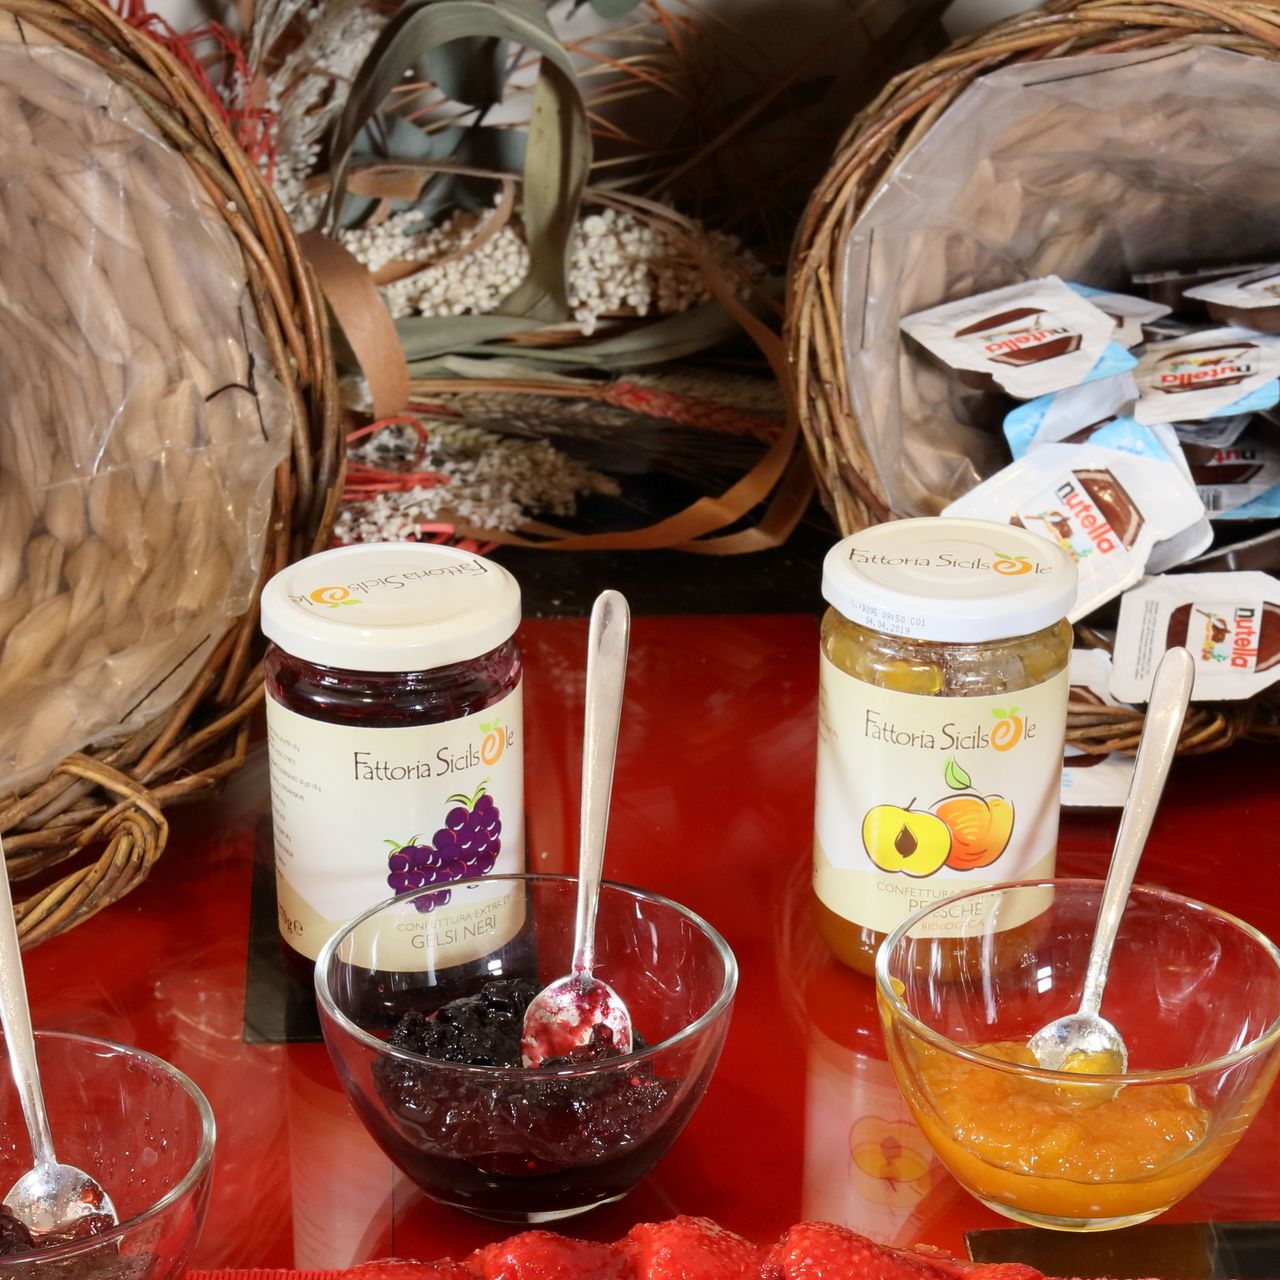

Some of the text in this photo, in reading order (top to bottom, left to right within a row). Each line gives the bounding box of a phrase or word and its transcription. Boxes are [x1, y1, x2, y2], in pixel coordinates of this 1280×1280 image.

[984, 327, 1070, 353] nutella
[1160, 364, 1251, 387] nutella
[1057, 482, 1117, 555] nutella
[403, 559, 489, 581] Fattoria
[849, 548, 930, 567] Fattoria
[1230, 607, 1259, 669] nutella
[864, 709, 935, 749] Fattoria
[354, 751, 431, 781] Fattoria
